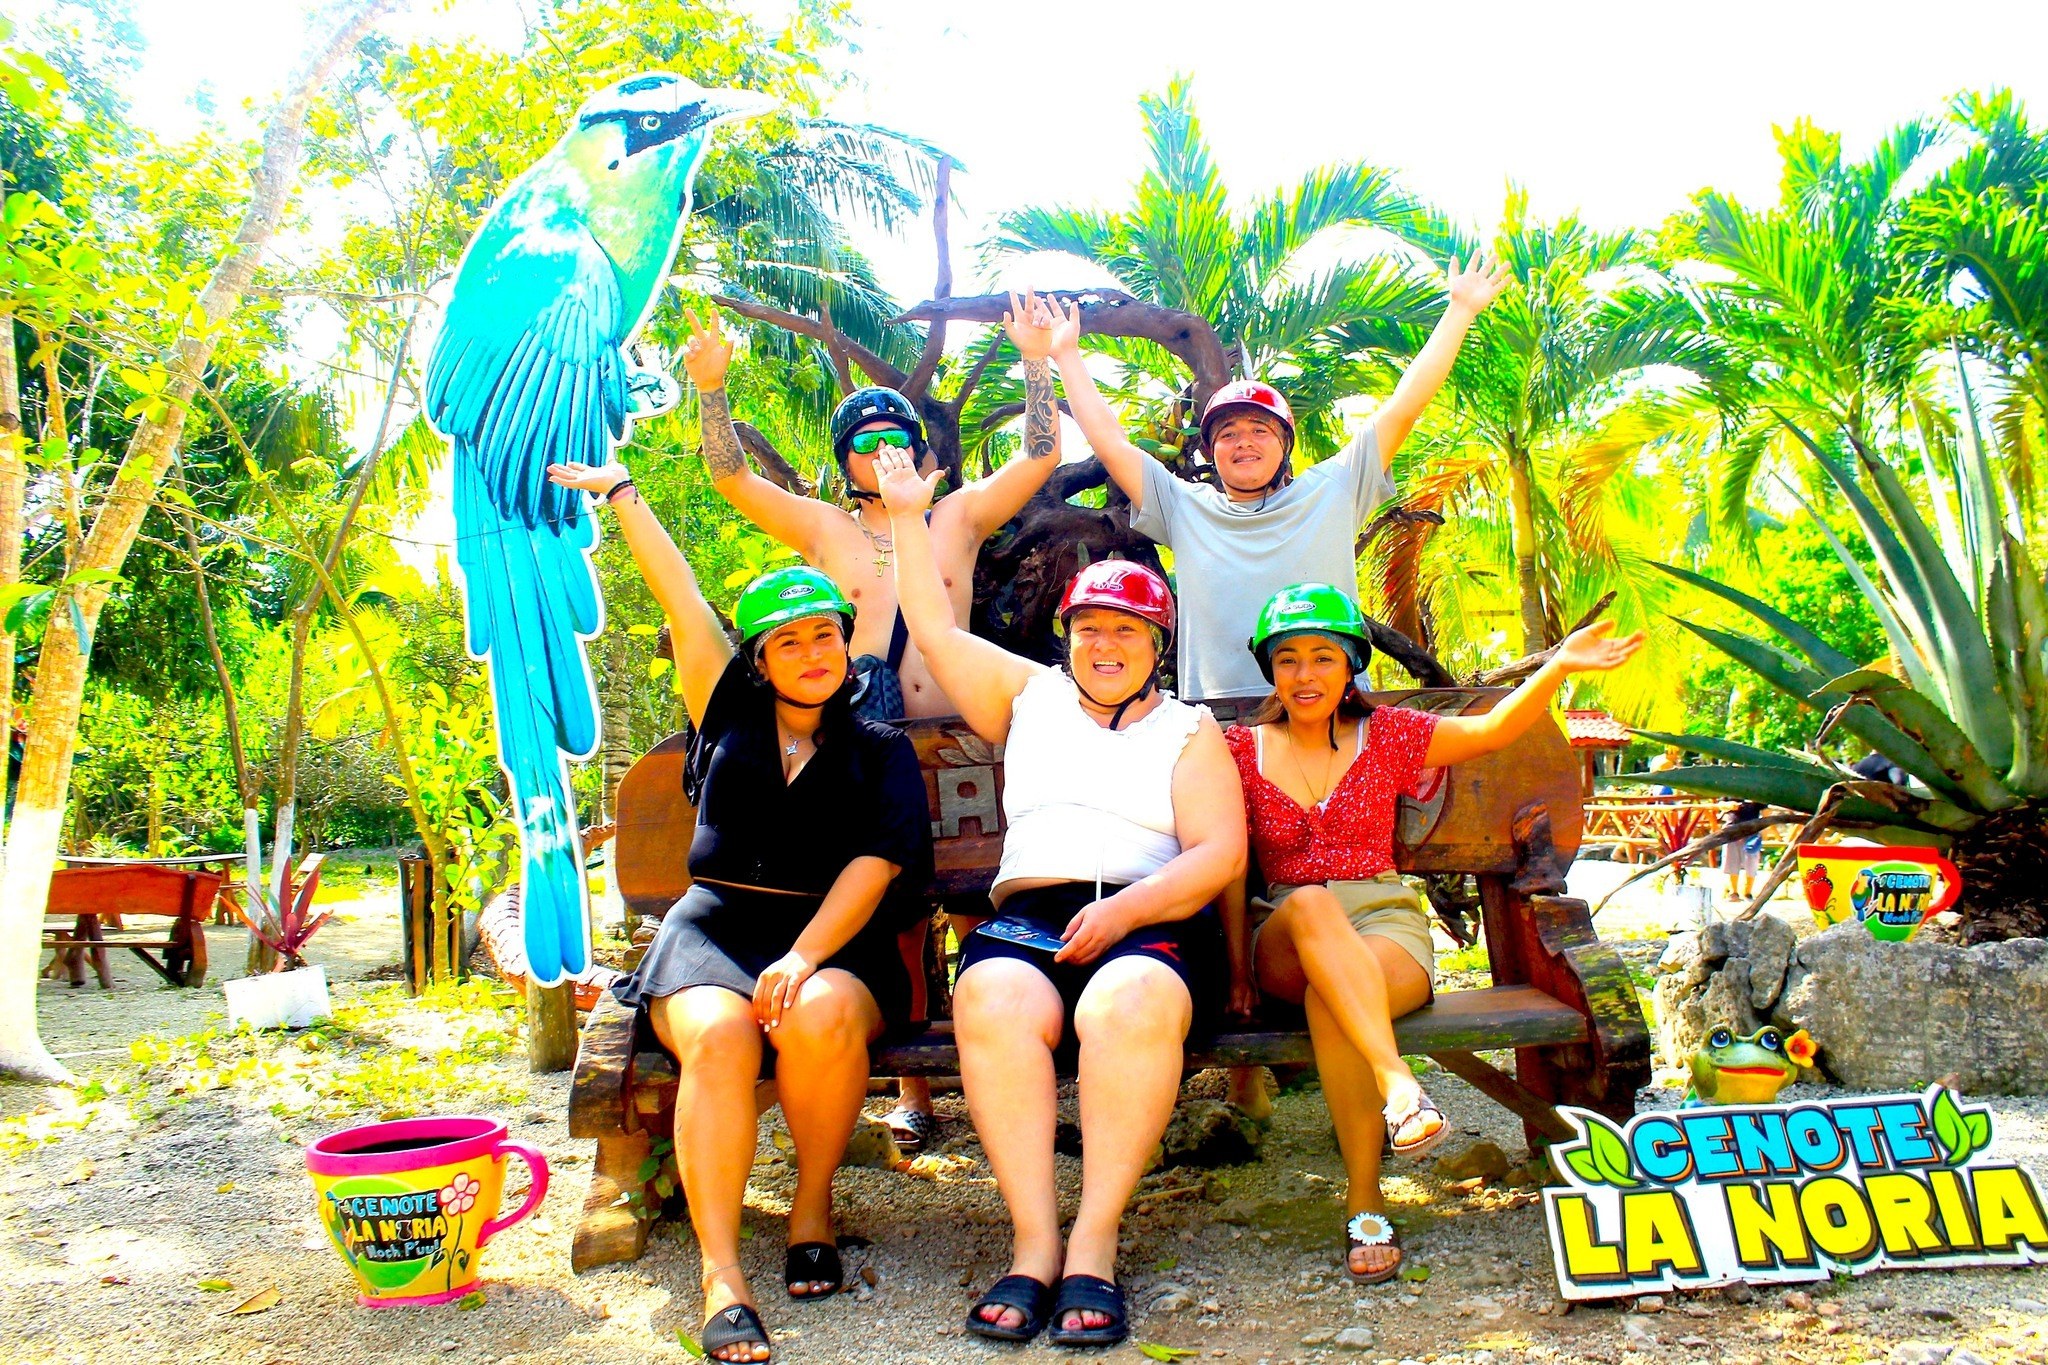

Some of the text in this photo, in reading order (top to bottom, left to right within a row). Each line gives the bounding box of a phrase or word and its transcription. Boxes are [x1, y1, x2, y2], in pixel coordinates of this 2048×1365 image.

[1876, 892, 1896, 912] LA
[1632, 1102, 1940, 1182] CENOTE
[351, 1191, 438, 1218] CENOTE
[348, 1218, 376, 1243] LA
[1556, 1167, 2048, 1280] LA NORIA
